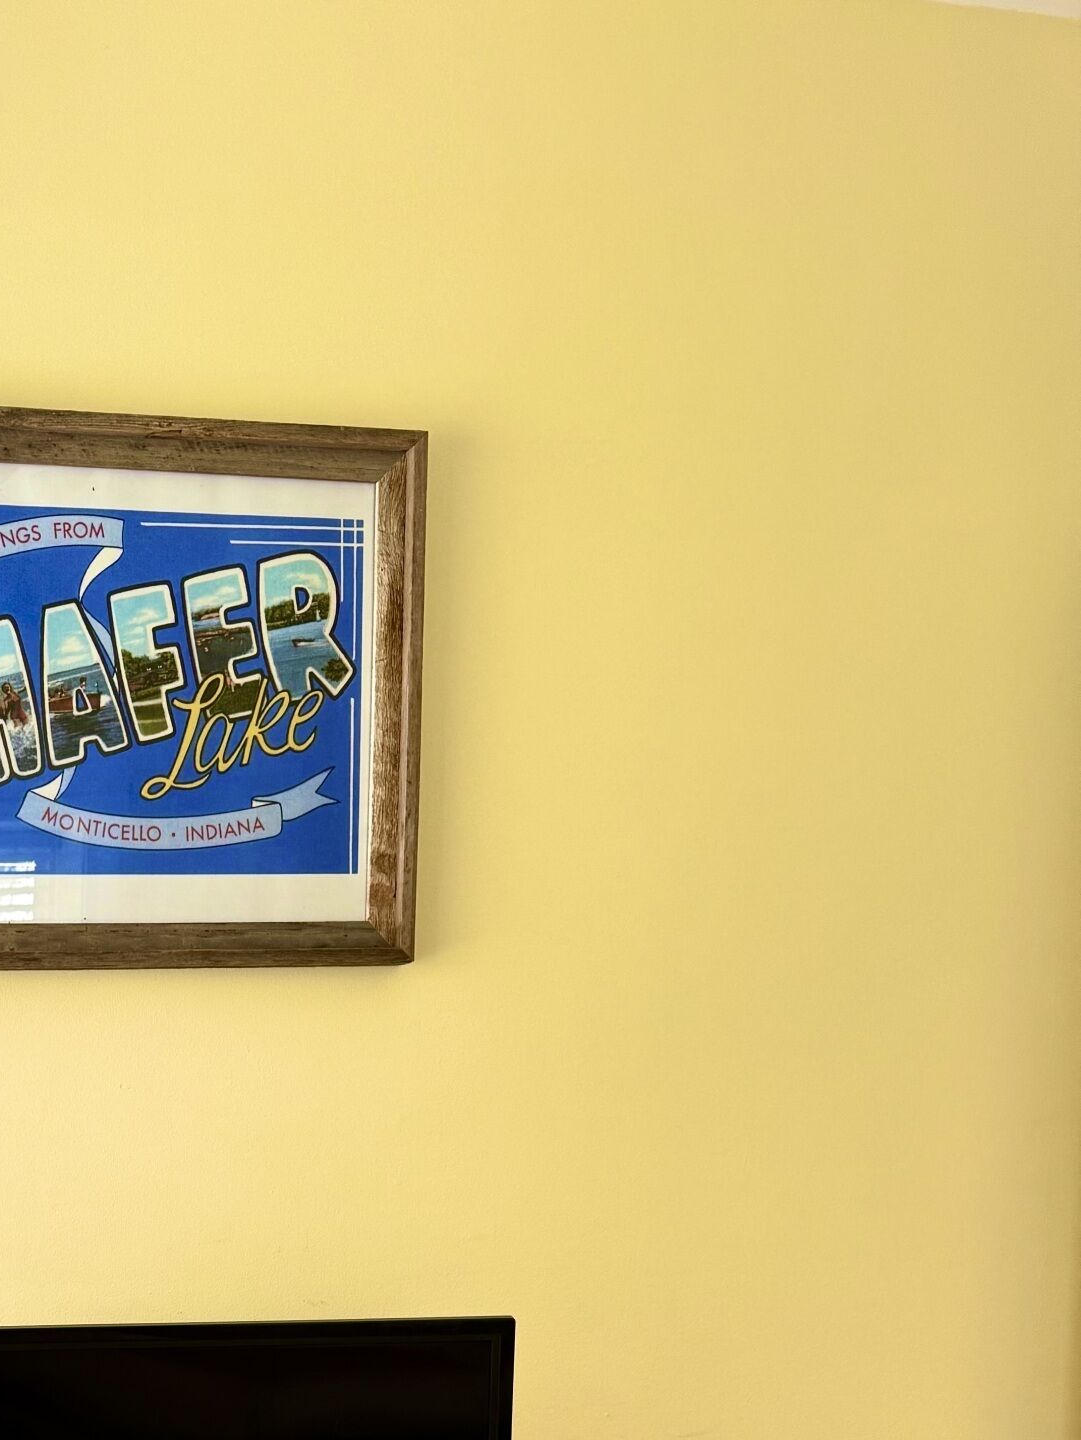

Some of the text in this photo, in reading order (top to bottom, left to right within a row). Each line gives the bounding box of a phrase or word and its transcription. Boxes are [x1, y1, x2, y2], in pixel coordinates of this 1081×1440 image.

[53, 522, 105, 539] FROM
[139, 673, 325, 801] Lake
[41, 806, 265, 842] MONTICELLO INDIANA
